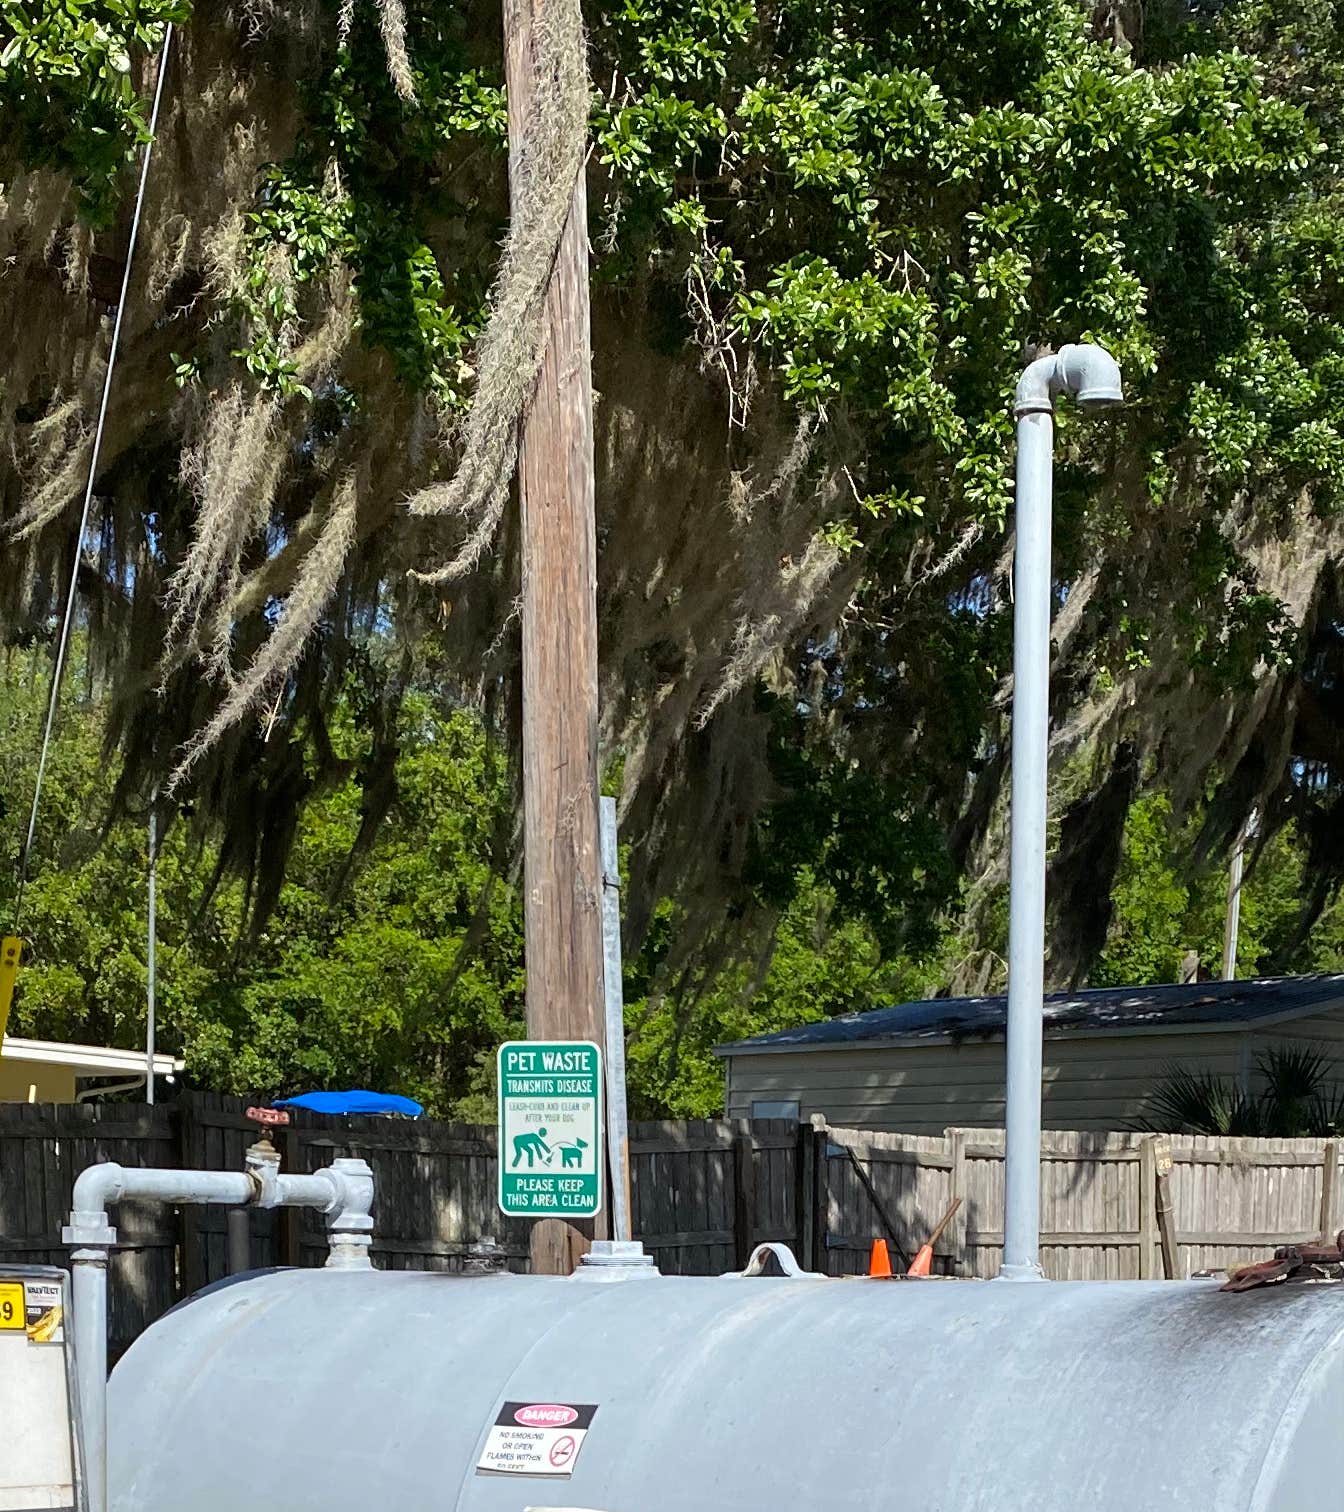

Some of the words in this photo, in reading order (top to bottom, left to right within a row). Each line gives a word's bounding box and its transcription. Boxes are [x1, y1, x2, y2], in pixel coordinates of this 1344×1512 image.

[508, 1052, 536, 1071] PET
[542, 1052, 591, 1071] WASTE
[507, 1080, 554, 1093] TRANSMITS
[557, 1080, 593, 1093] DISEASE
[545, 1102, 560, 1111] AND
[561, 1102, 580, 1111] CLEAN
[582, 1102, 591, 1111] UP
[525, 1114, 542, 1122] AFTER
[544, 1114, 560, 1122] YOUR
[563, 1114, 574, 1122] DOG
[516, 1178, 555, 1192] PLEASE
[558, 1179, 585, 1192] KEEP
[506, 1193, 529, 1207] THIS
[531, 1193, 558, 1207] AREA
[561, 1194, 594, 1207] CLEAN
[522, 1410, 570, 1421] DANGER
[512, 1432, 544, 1440] SMOKING
[486, 1452, 514, 1460] FLAMES
